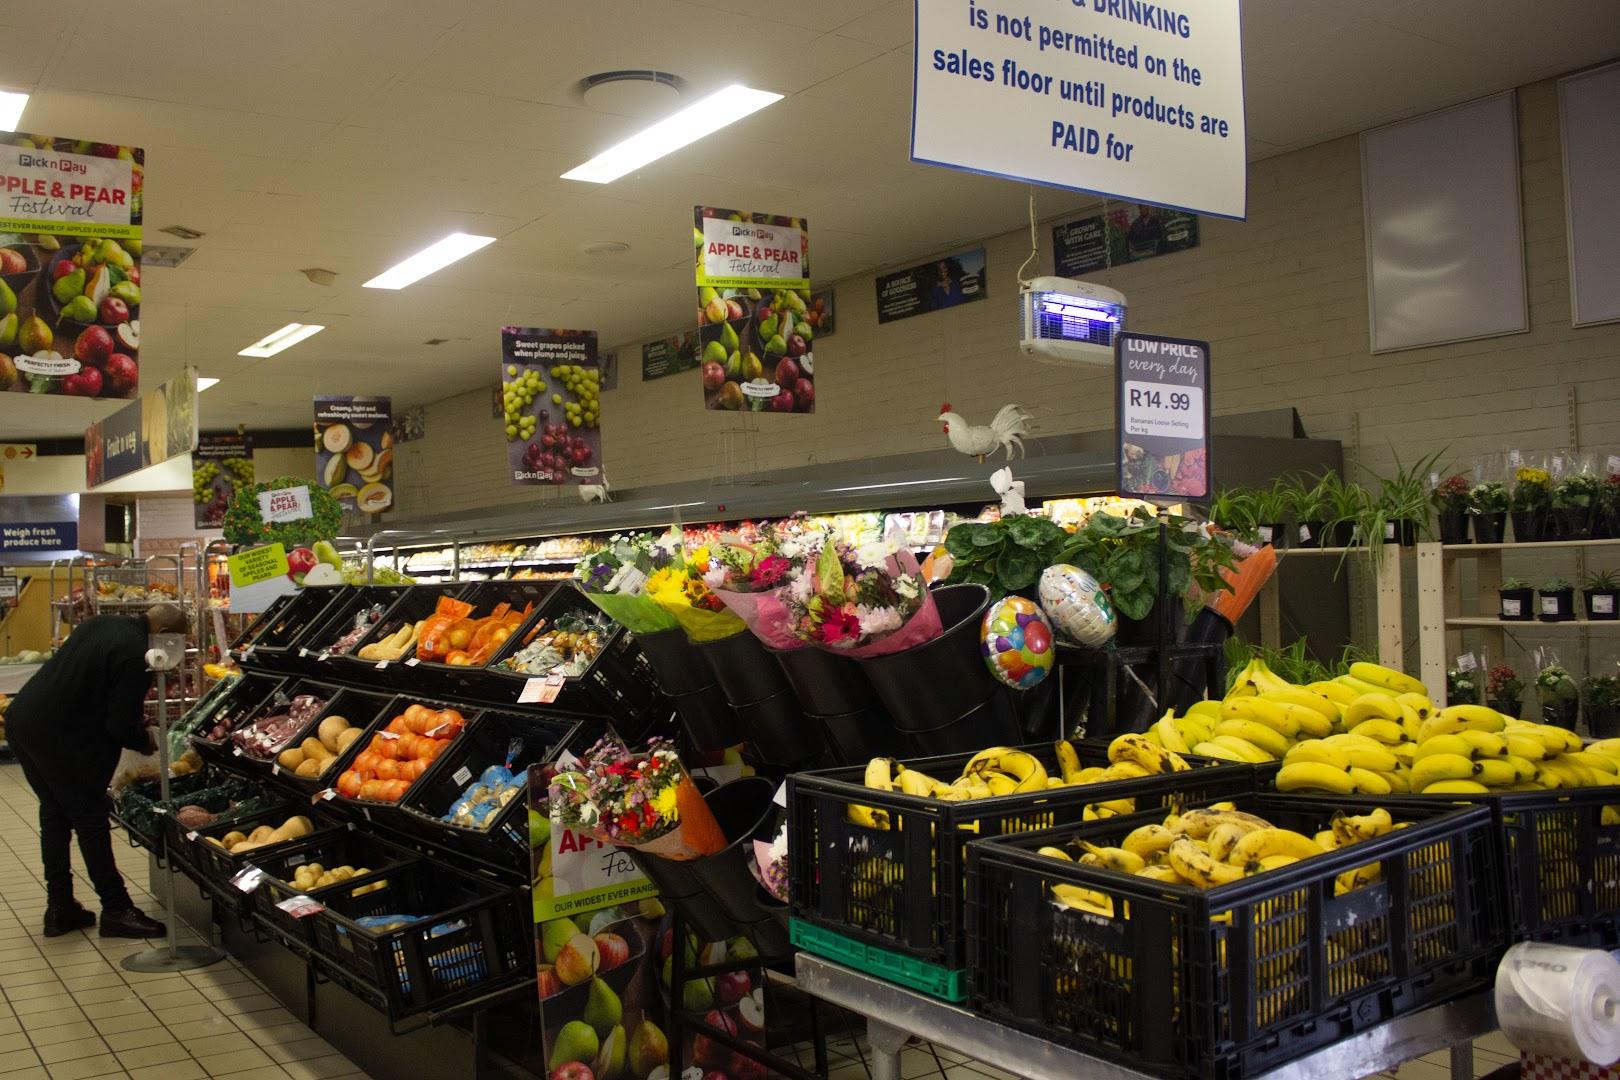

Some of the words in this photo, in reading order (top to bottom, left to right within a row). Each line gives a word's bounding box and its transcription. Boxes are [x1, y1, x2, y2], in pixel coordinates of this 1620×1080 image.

[1094, 0, 1190, 38] DRINKING
[969, 1, 989, 30] is
[996, 13, 1032, 41] not
[1039, 24, 1138, 69] permitted
[1144, 53, 1166, 77] on
[1173, 57, 1202, 87] the
[933, 48, 995, 82] sales
[1002, 58, 1053, 95] floor
[1060, 78, 1104, 109] until
[1112, 91, 1195, 131] products
[1201, 113, 1229, 138] are
[1052, 121, 1100, 155] PAID
[1106, 132, 1133, 163] for
[19, 154, 49, 169] Pick
[50, 161, 58, 169] n
[59, 159, 87, 175] Pay
[50, 181, 65, 199] &
[70, 184, 125, 205] PEAR
[9, 196, 95, 217] Festival
[708, 242, 751, 259] APPLE
[752, 246, 762, 260] &
[764, 247, 799, 263] PEAR
[729, 259, 780, 274] Festival
[514, 349, 534, 357] when
[533, 350, 555, 359] plump
[555, 351, 568, 359] and
[515, 340, 539, 349] Sweet
[538, 342, 562, 350] grapes
[562, 342, 585, 351] picked
[1128, 338, 1158, 354] LOW
[1161, 342, 1198, 358] PRICE
[1128, 359, 1166, 379] every
[1168, 356, 1198, 383] day
[1130, 388, 1190, 411] R14.99
[270, 495, 296, 505] APPLE
[277, 502, 298, 510] PEAR
[3, 528, 31, 538] Weigh
[32, 527, 57, 536] fresh
[3, 538, 40, 548] produce
[41, 537, 62, 546] here
[601, 850, 636, 877] Fes
[554, 901, 573, 913] OUR
[575, 893, 607, 908] WIDEST
[607, 888, 630, 899] EVER
[630, 883, 657, 896] RANG
